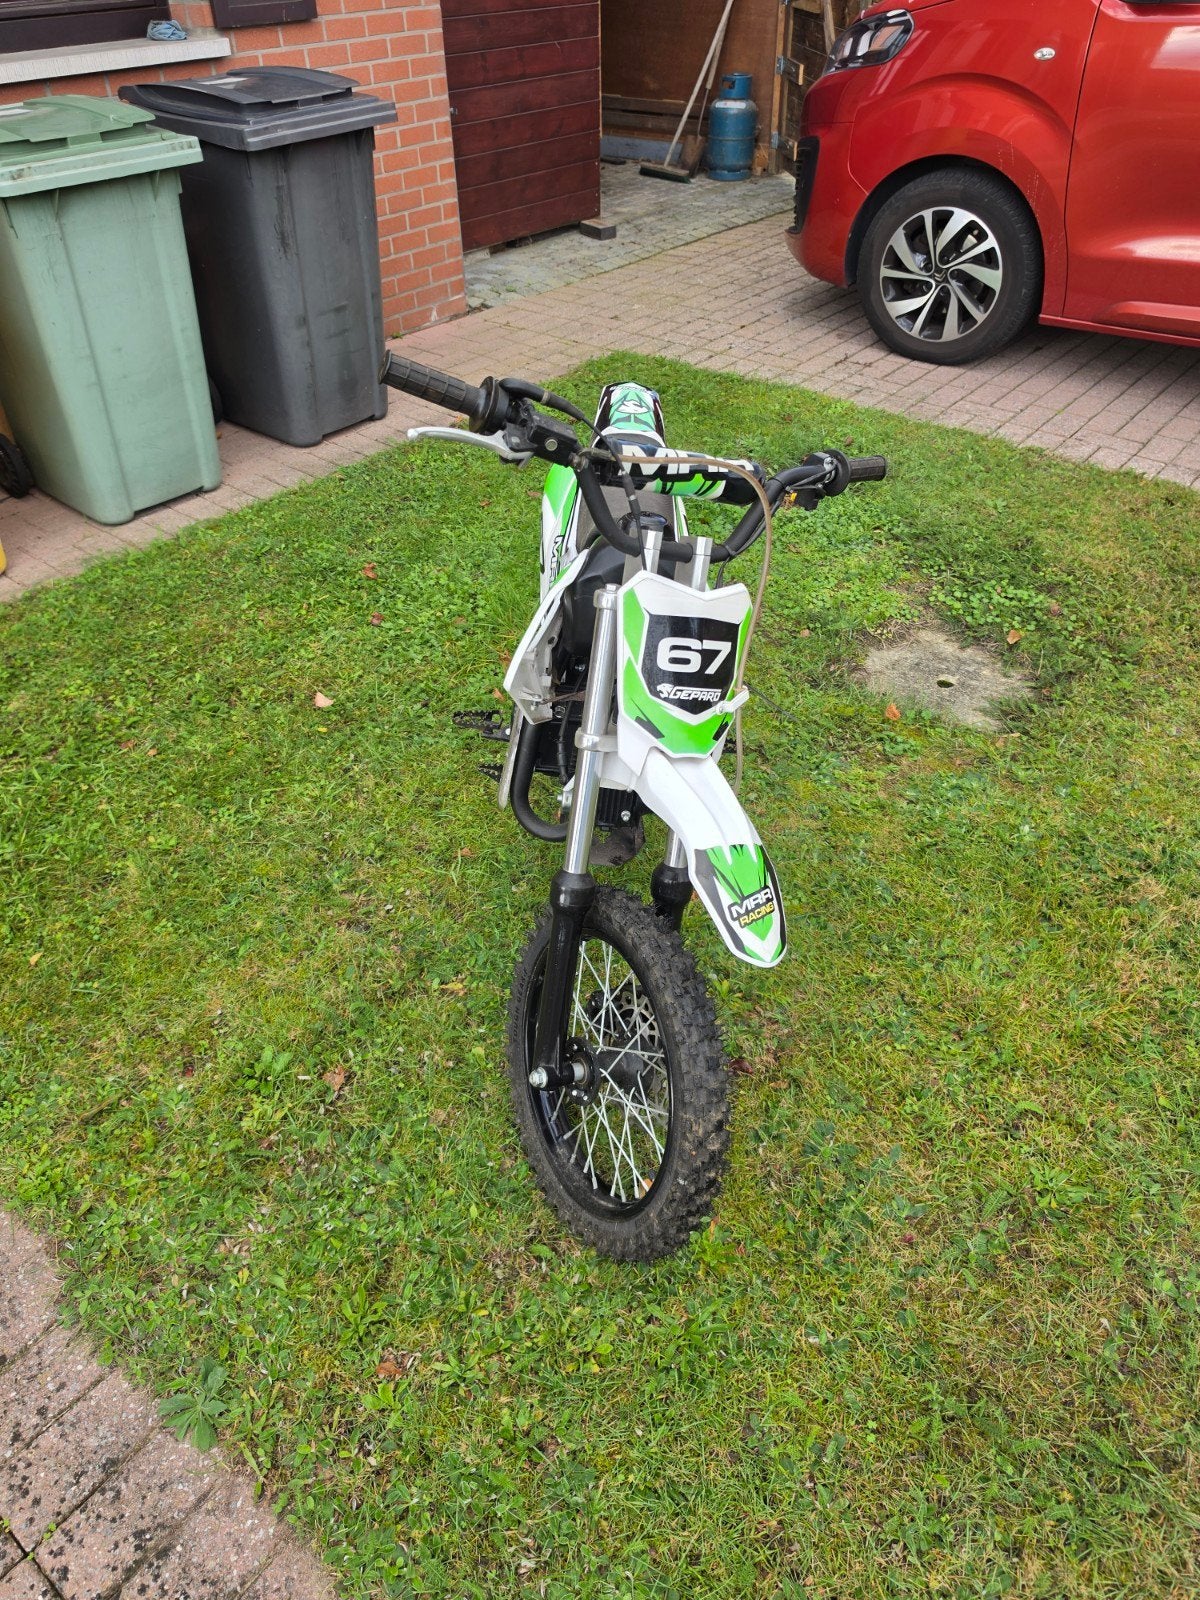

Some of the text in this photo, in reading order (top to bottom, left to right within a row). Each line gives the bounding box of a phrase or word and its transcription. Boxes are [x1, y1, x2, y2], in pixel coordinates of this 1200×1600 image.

[656, 636, 732, 675] 67
[668, 685, 722, 702] GEPARD
[730, 887, 773, 919] MRR
[739, 901, 774, 927] RACING
